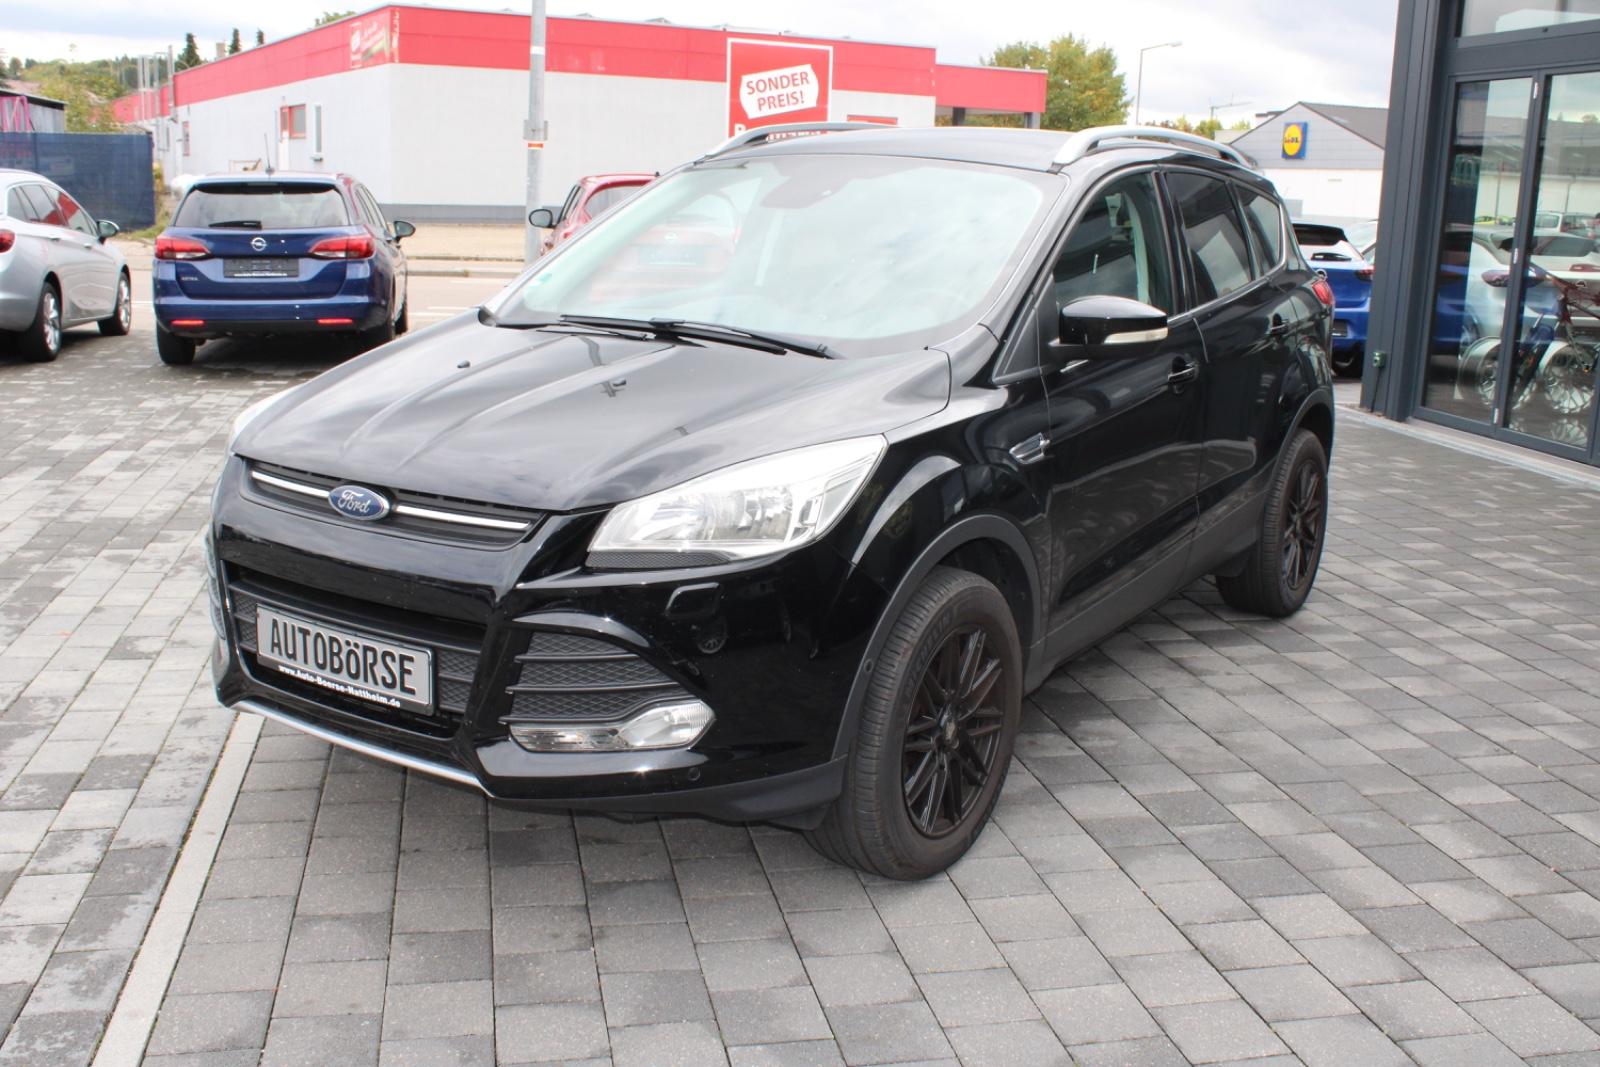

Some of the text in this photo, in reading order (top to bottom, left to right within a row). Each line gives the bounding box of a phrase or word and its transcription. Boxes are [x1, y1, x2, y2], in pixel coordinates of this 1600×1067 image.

[746, 71, 809, 95] SONDER
[757, 91, 804, 111] PREIS!
[338, 490, 371, 513] Ford
